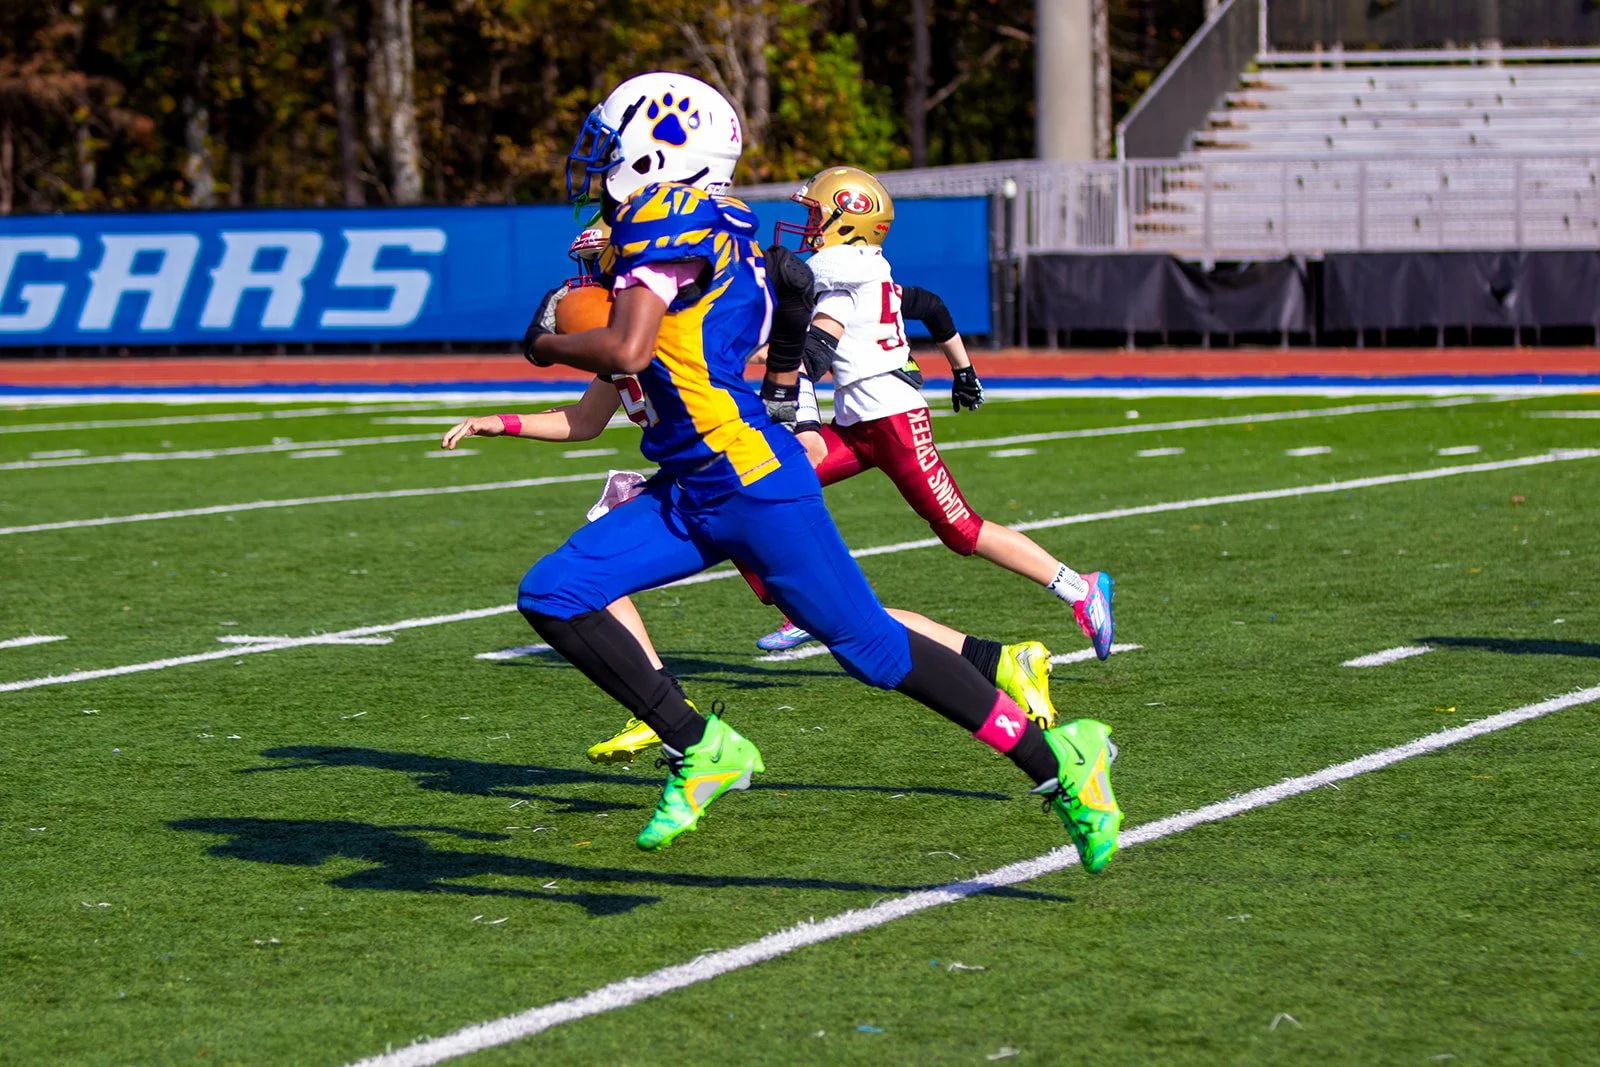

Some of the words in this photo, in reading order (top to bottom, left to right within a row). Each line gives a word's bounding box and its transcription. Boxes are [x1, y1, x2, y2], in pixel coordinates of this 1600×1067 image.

[0, 228, 446, 333] GARS
[907, 409, 939, 472] CREEK
[927, 467, 970, 524] JOHNS
